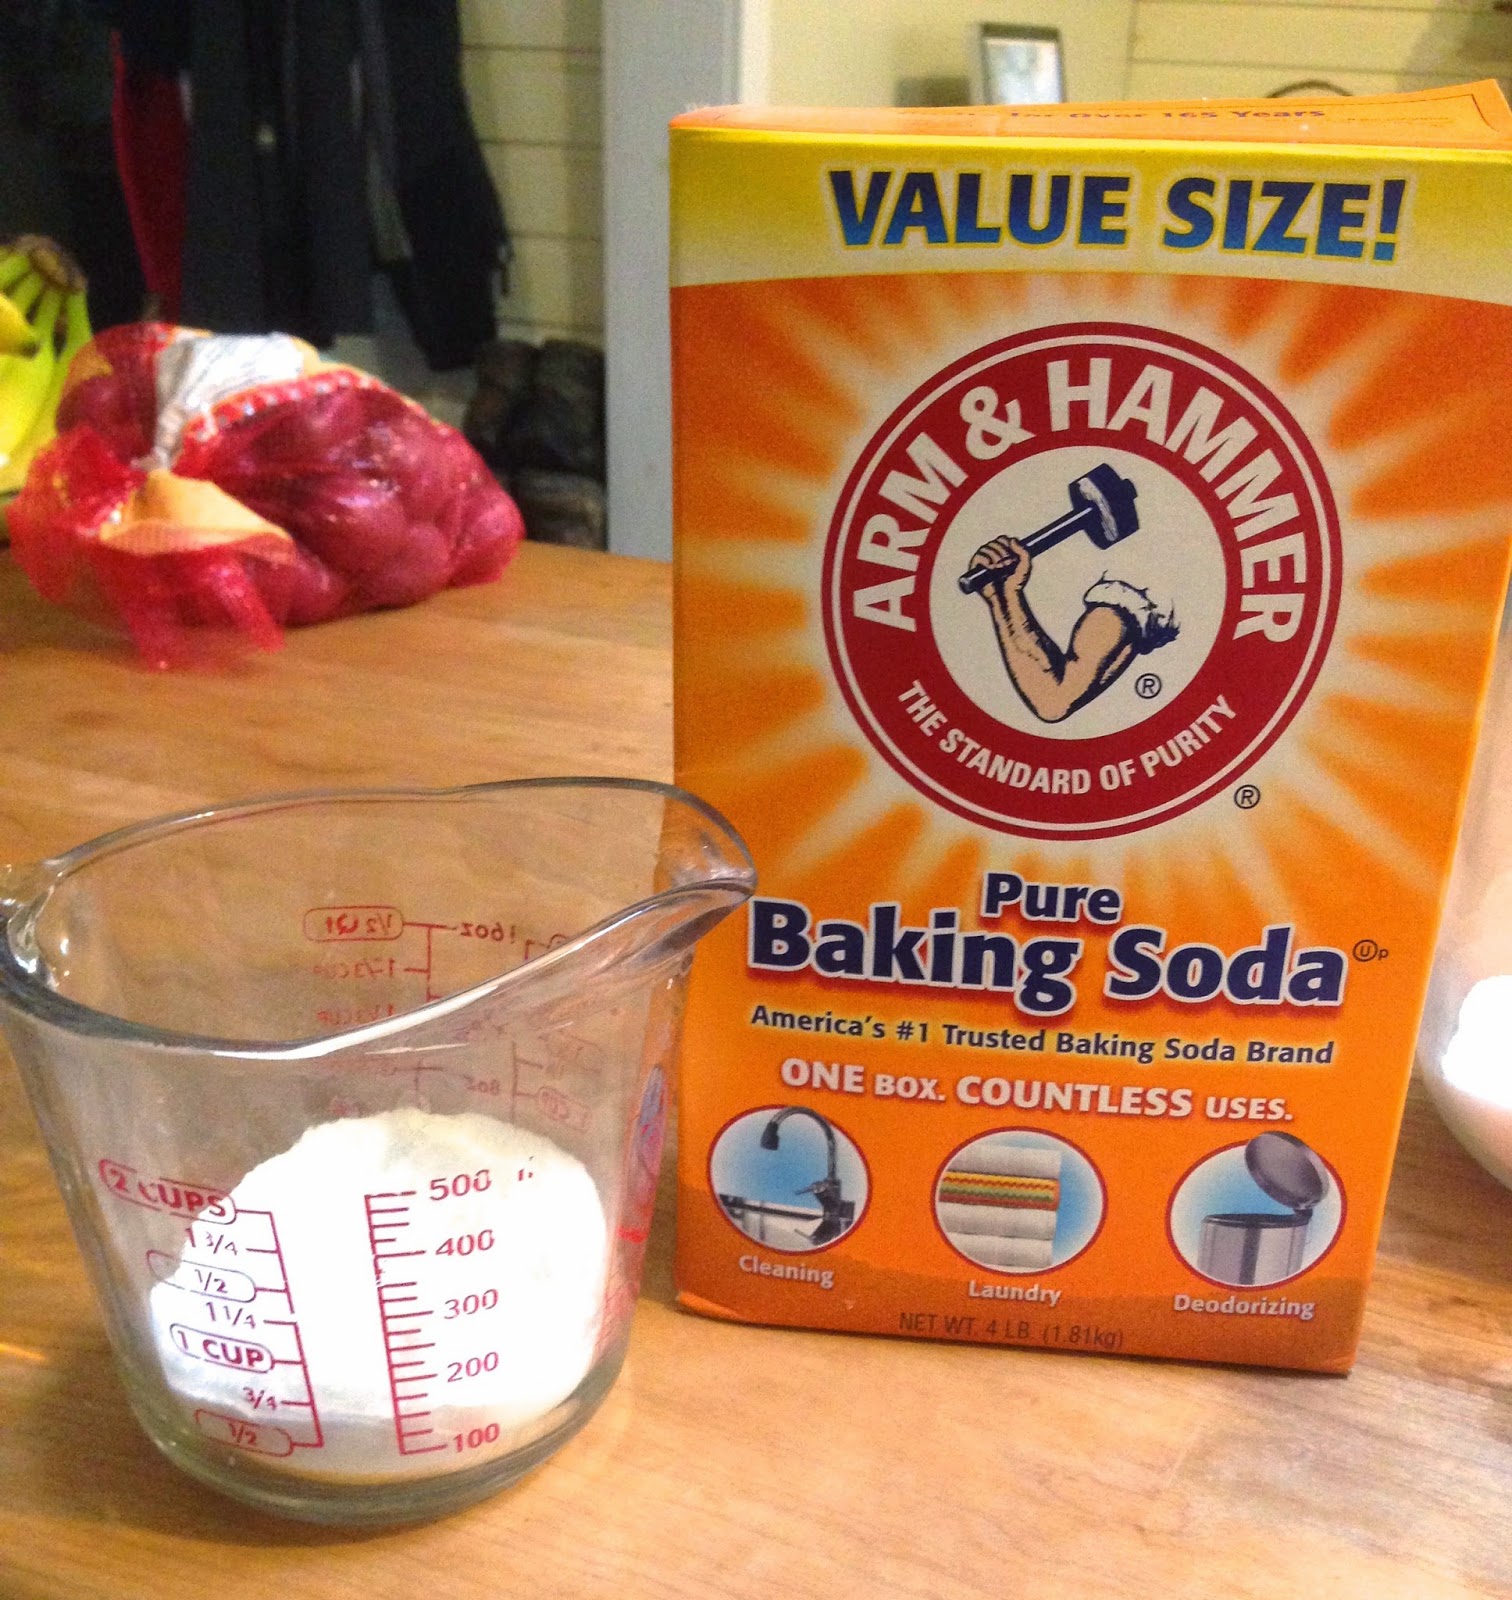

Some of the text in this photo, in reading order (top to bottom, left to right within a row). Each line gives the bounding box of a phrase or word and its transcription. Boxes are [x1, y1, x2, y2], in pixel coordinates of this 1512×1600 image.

[1231, 106, 1326, 118] Years
[829, 170, 1408, 262] VALUE SIZE!
[853, 357, 1307, 643] ARM & HAMMER
[897, 680, 1237, 796] THE STANDARD OF PURITY
[983, 872, 1121, 923] Pure
[748, 897, 1079, 1016] Baking
[1105, 925, 1346, 1007] Soda
[751, 1006, 1335, 1066] America's #1 Trusted Baking Soda Brand
[781, 1058, 1294, 1123] ONE BOX. COUNTLESS USES.
[429, 1169, 492, 1200] 500
[185, 1226, 238, 1255] 1 3/4
[435, 1229, 495, 1256] 400
[195, 1269, 228, 1294] 1/2
[738, 1254, 835, 1290] Cleaning
[443, 1288, 499, 1320] 300
[968, 1280, 1062, 1307] Laundry
[1173, 1293, 1316, 1320] Deodorizing
[899, 1311, 939, 1334] NET
[985, 1317, 998, 1339] 4
[1042, 1321, 1124, 1349] (1.81kg)
[203, 1337, 264, 1367] CUP
[446, 1352, 499, 1383] 200
[242, 1387, 277, 1410] 3/4
[227, 1422, 258, 1446] 1/2
[453, 1423, 500, 1453] 100
